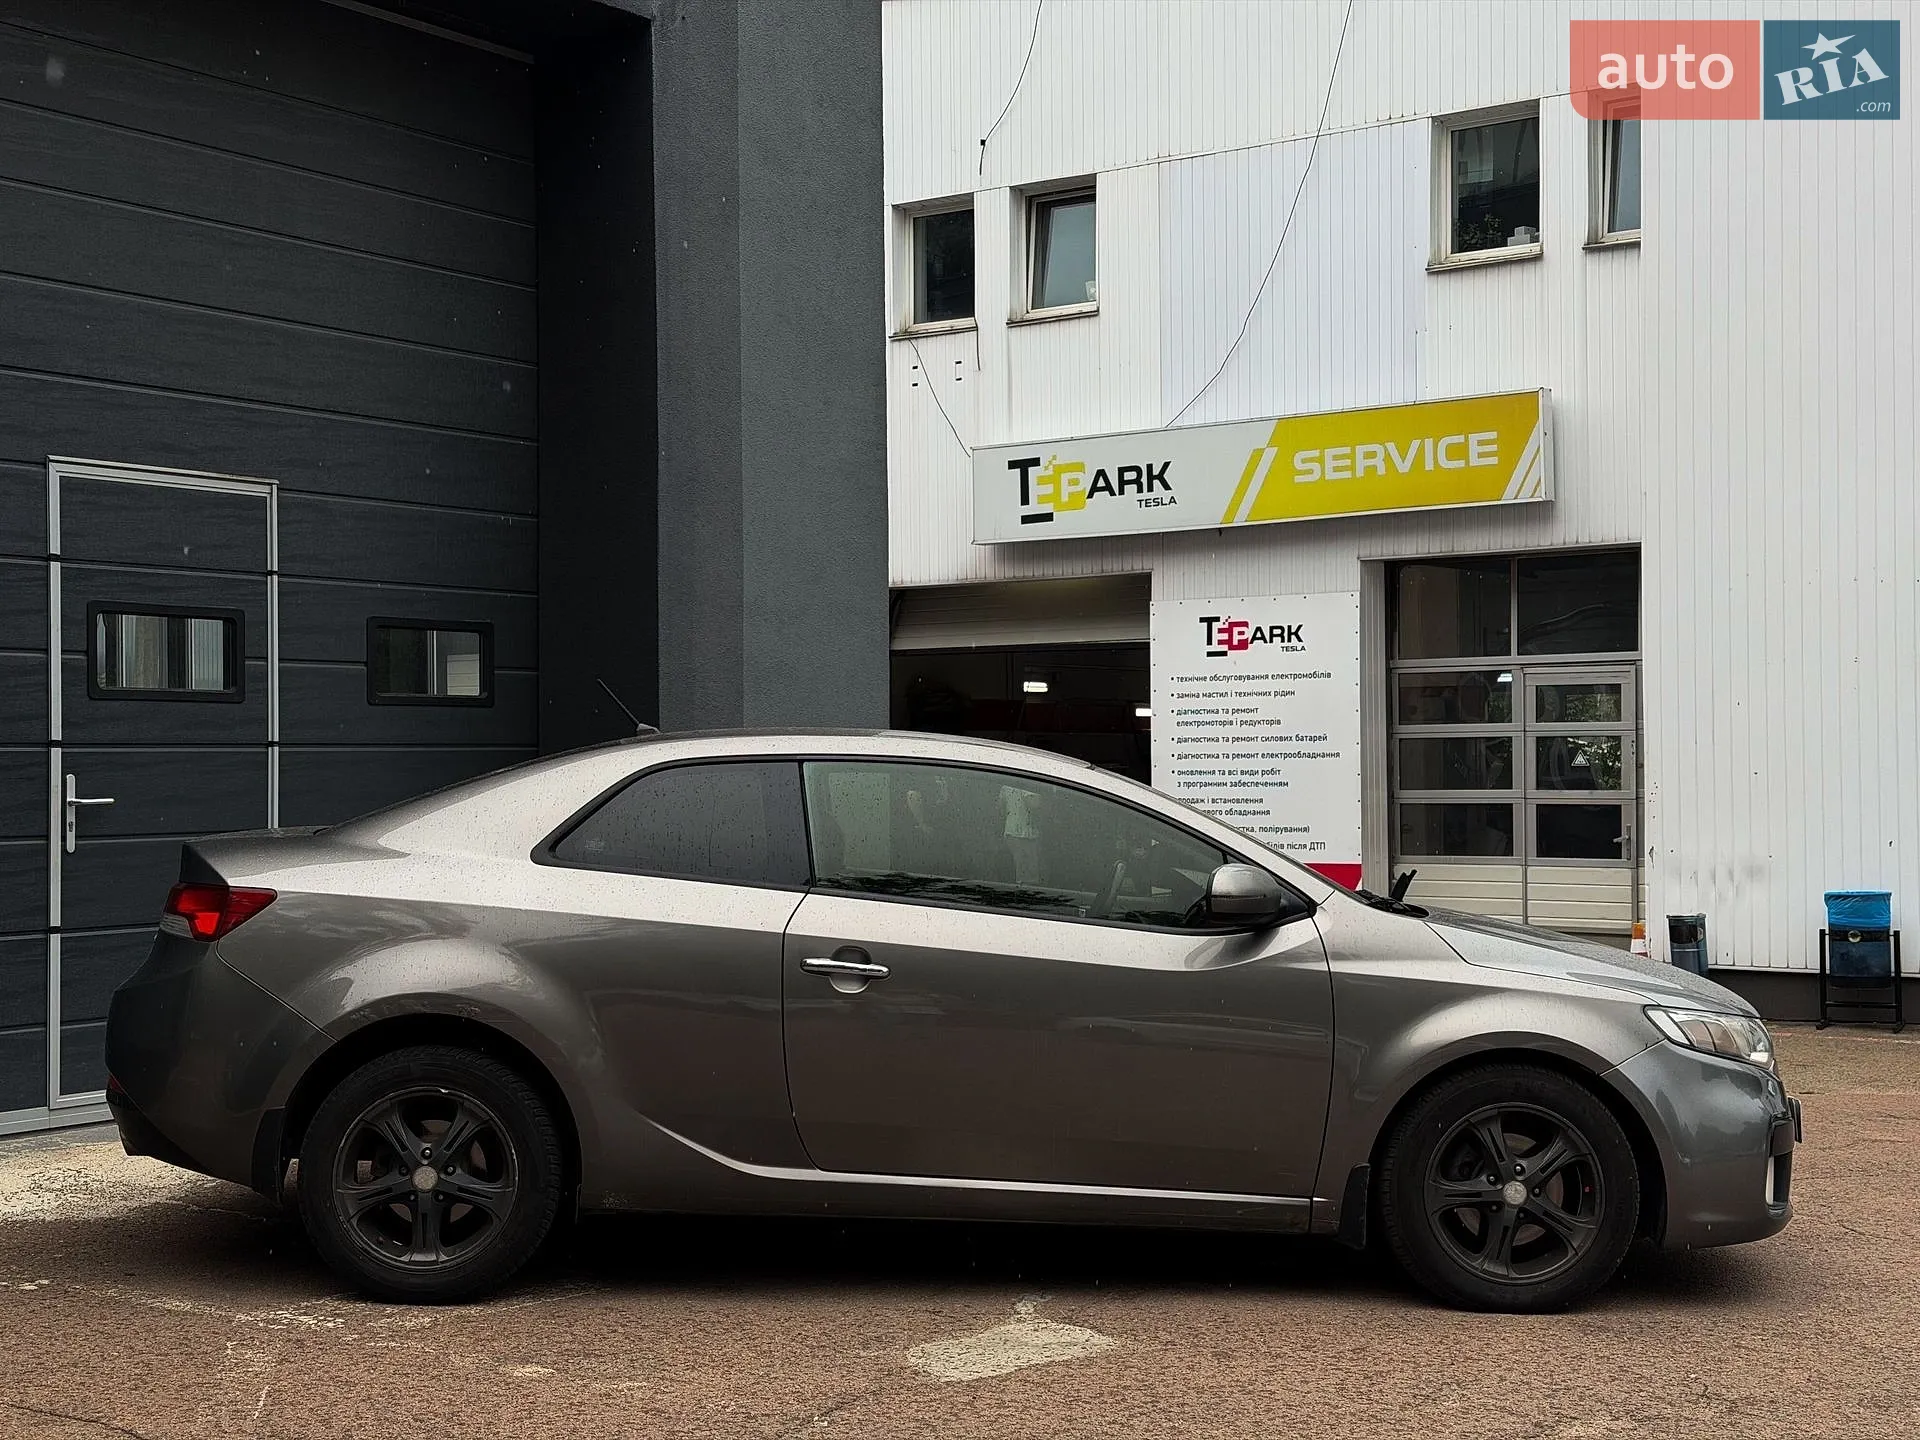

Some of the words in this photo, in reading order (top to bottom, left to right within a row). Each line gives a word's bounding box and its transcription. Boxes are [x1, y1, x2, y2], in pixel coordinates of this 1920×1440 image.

[1293, 431, 1498, 484] SERVICE
[1136, 496, 1178, 509] TESLA
[1177, 675, 1207, 683] технічне
[1209, 673, 1269, 682] обслуговування
[1271, 671, 1332, 679] електромобілів
[1177, 691, 1201, 699] заміна
[1235, 690, 1272, 698] технічних
[1274, 689, 1295, 698] рідин
[1177, 707, 1219, 716] діагностика
[1232, 707, 1259, 715] ремонт
[1177, 719, 1234, 727] електромоторів
[1240, 718, 1281, 727] редукторів
[1177, 736, 1220, 744] діагностика
[1295, 734, 1327, 743] батарей
[1177, 752, 1220, 760] діагностика
[1232, 752, 1259, 760] ремонт
[1261, 751, 1340, 760] електрообладнання
[1228, 768, 1239, 776] всі
[1240, 769, 1259, 777] види
[1261, 768, 1281, 776] робіт
[1183, 781, 1227, 789] програмним
[1229, 780, 1288, 788] забеспеченням
[1225, 808, 1270, 817] обладнання
[1258, 825, 1310, 834] полірування)
[1287, 842, 1307, 850] після
[1309, 842, 1326, 851] ДТП
